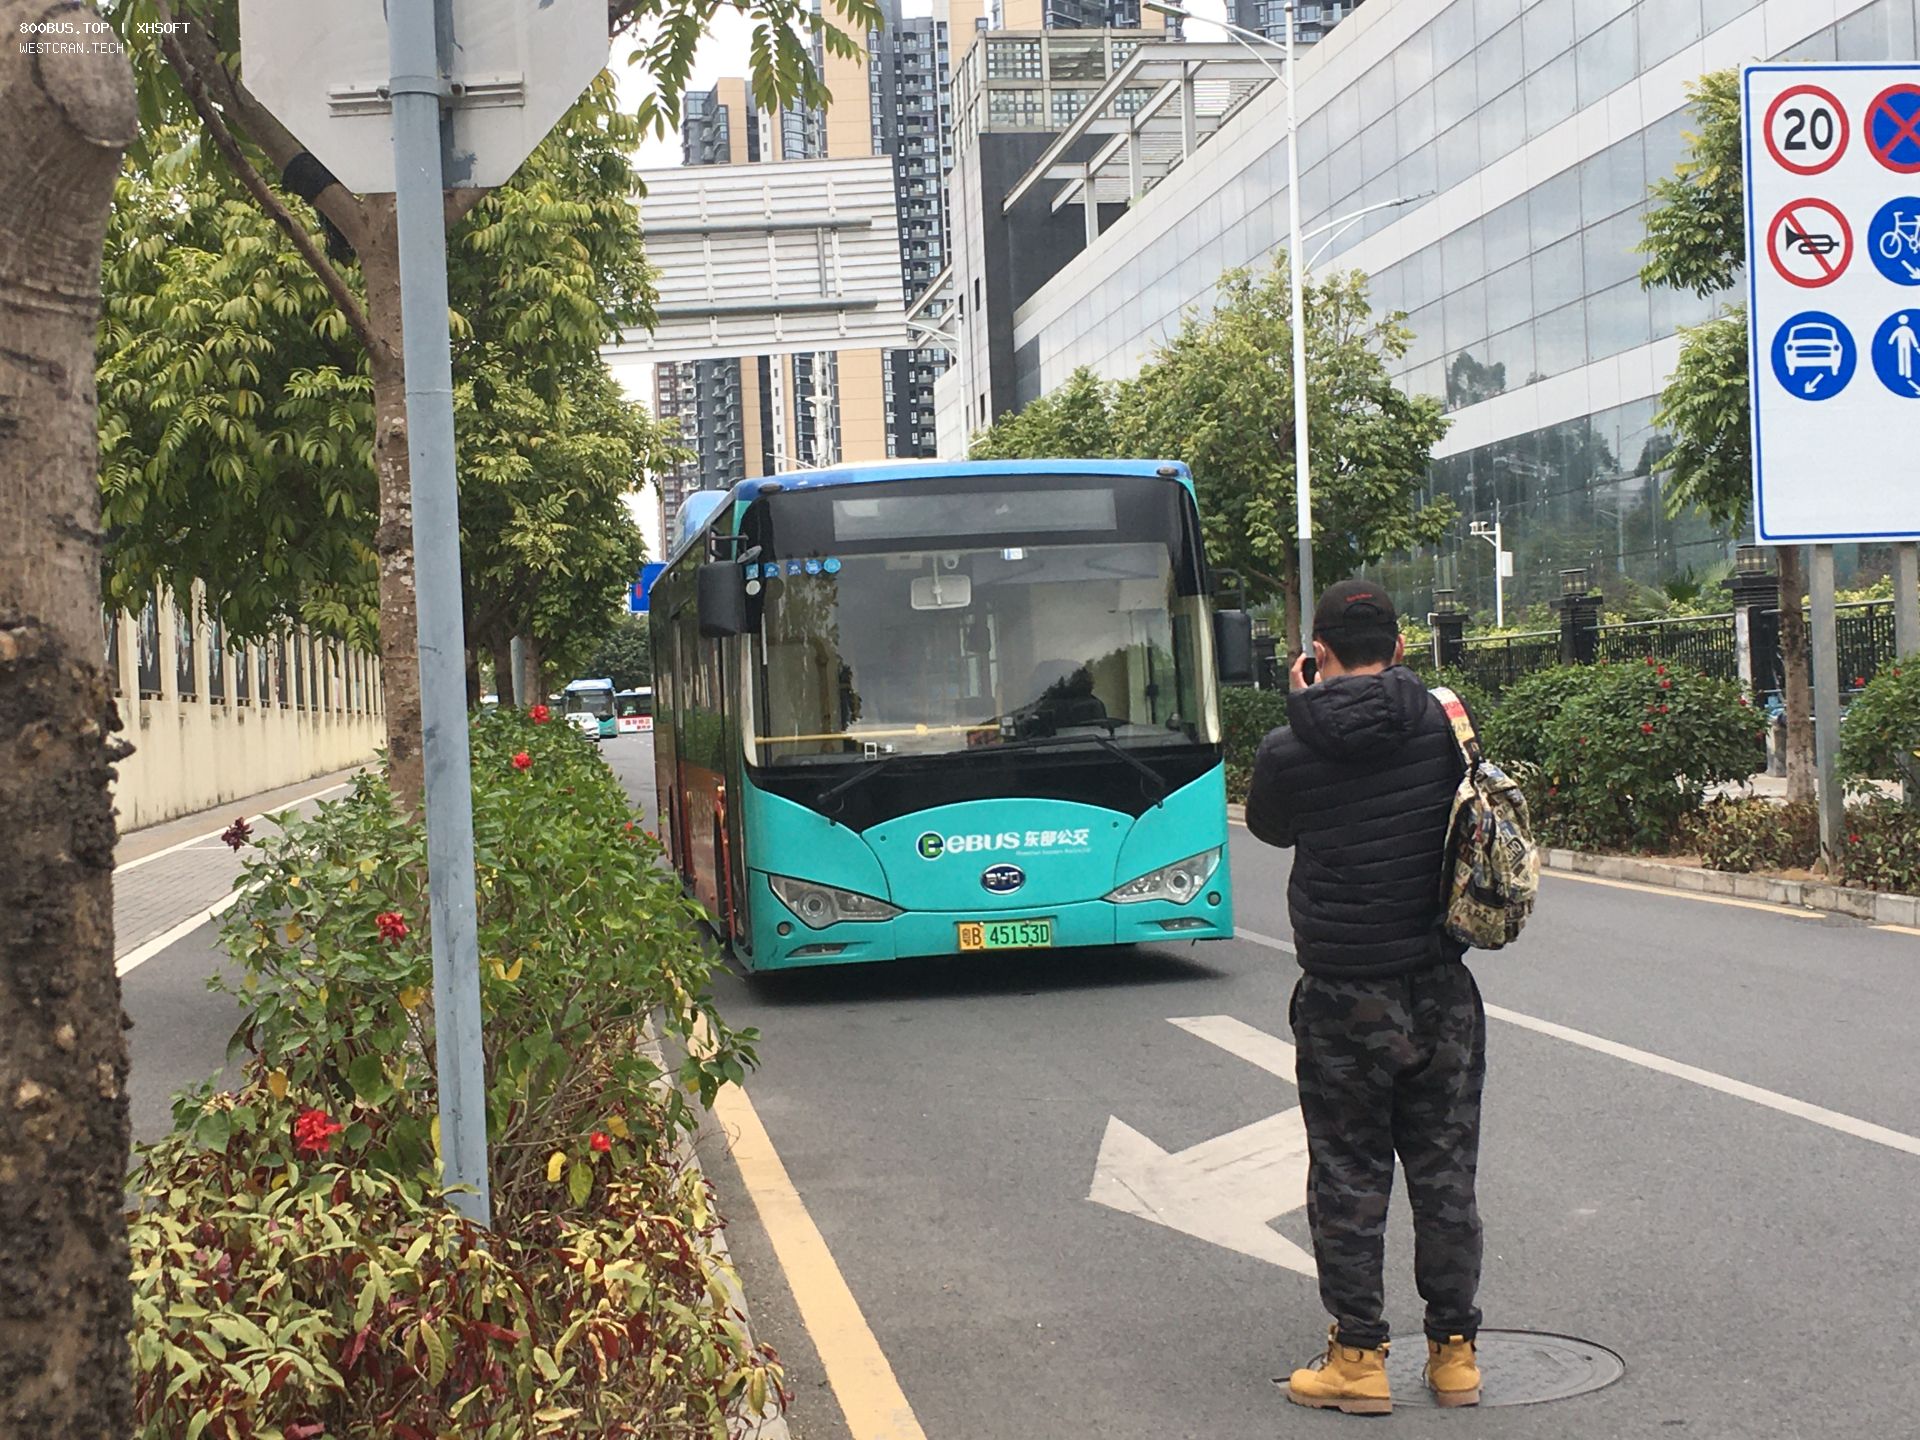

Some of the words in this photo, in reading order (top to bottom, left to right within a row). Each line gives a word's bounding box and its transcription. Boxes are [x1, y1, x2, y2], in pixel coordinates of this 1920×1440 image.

[1783, 107, 1834, 150] 20
[1023, 828, 1090, 847] 东部公交
[986, 871, 1020, 886] BYD
[990, 924, 1050, 945] 45153D
